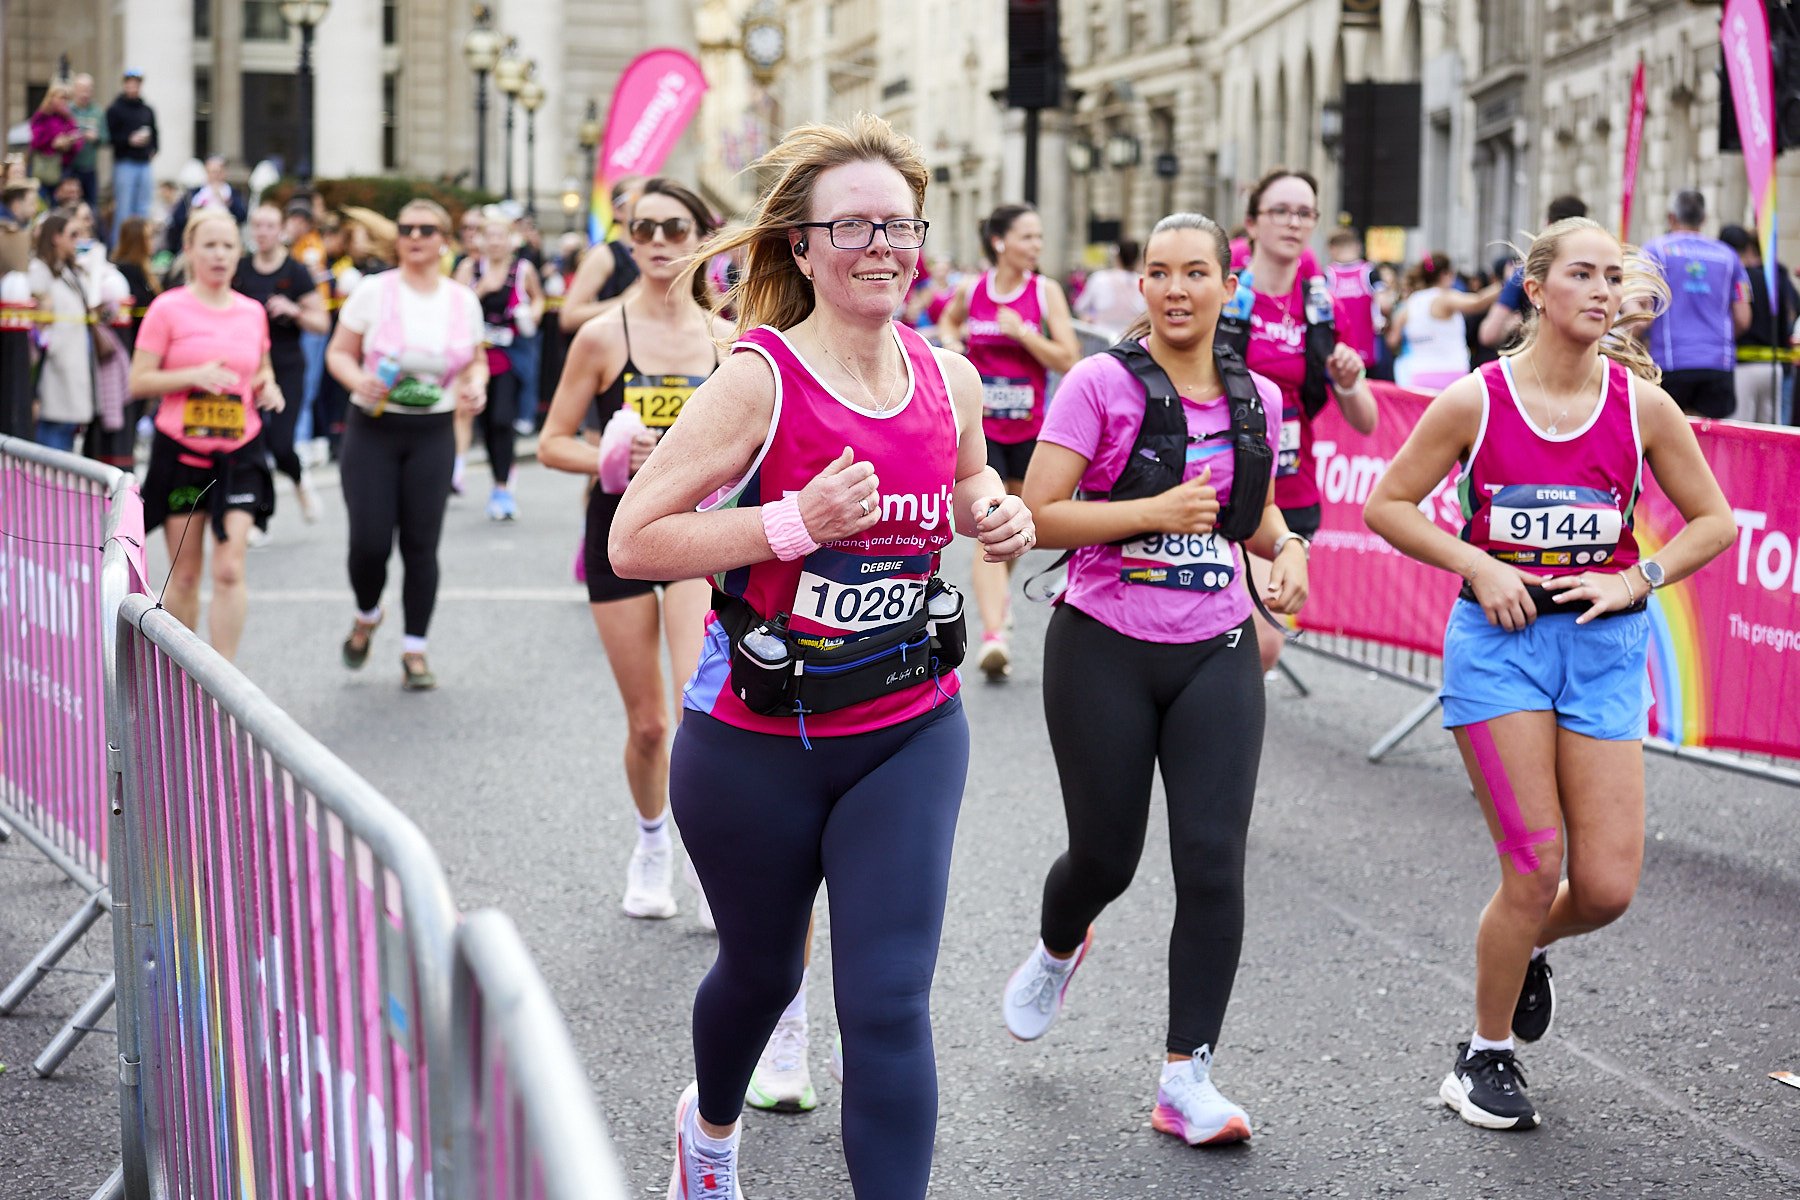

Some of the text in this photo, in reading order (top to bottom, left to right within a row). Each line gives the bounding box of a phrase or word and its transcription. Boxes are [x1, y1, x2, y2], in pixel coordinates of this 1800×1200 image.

[1536, 489, 1577, 501] ETOILE
[1510, 511, 1601, 541] 9144
[819, 539, 870, 551] gnancy
[871, 535, 894, 545] and
[896, 535, 926, 549] baby
[860, 560, 904, 574] DEBBIE
[811, 582, 925, 623] 10287
[1729, 612, 1750, 641] The
